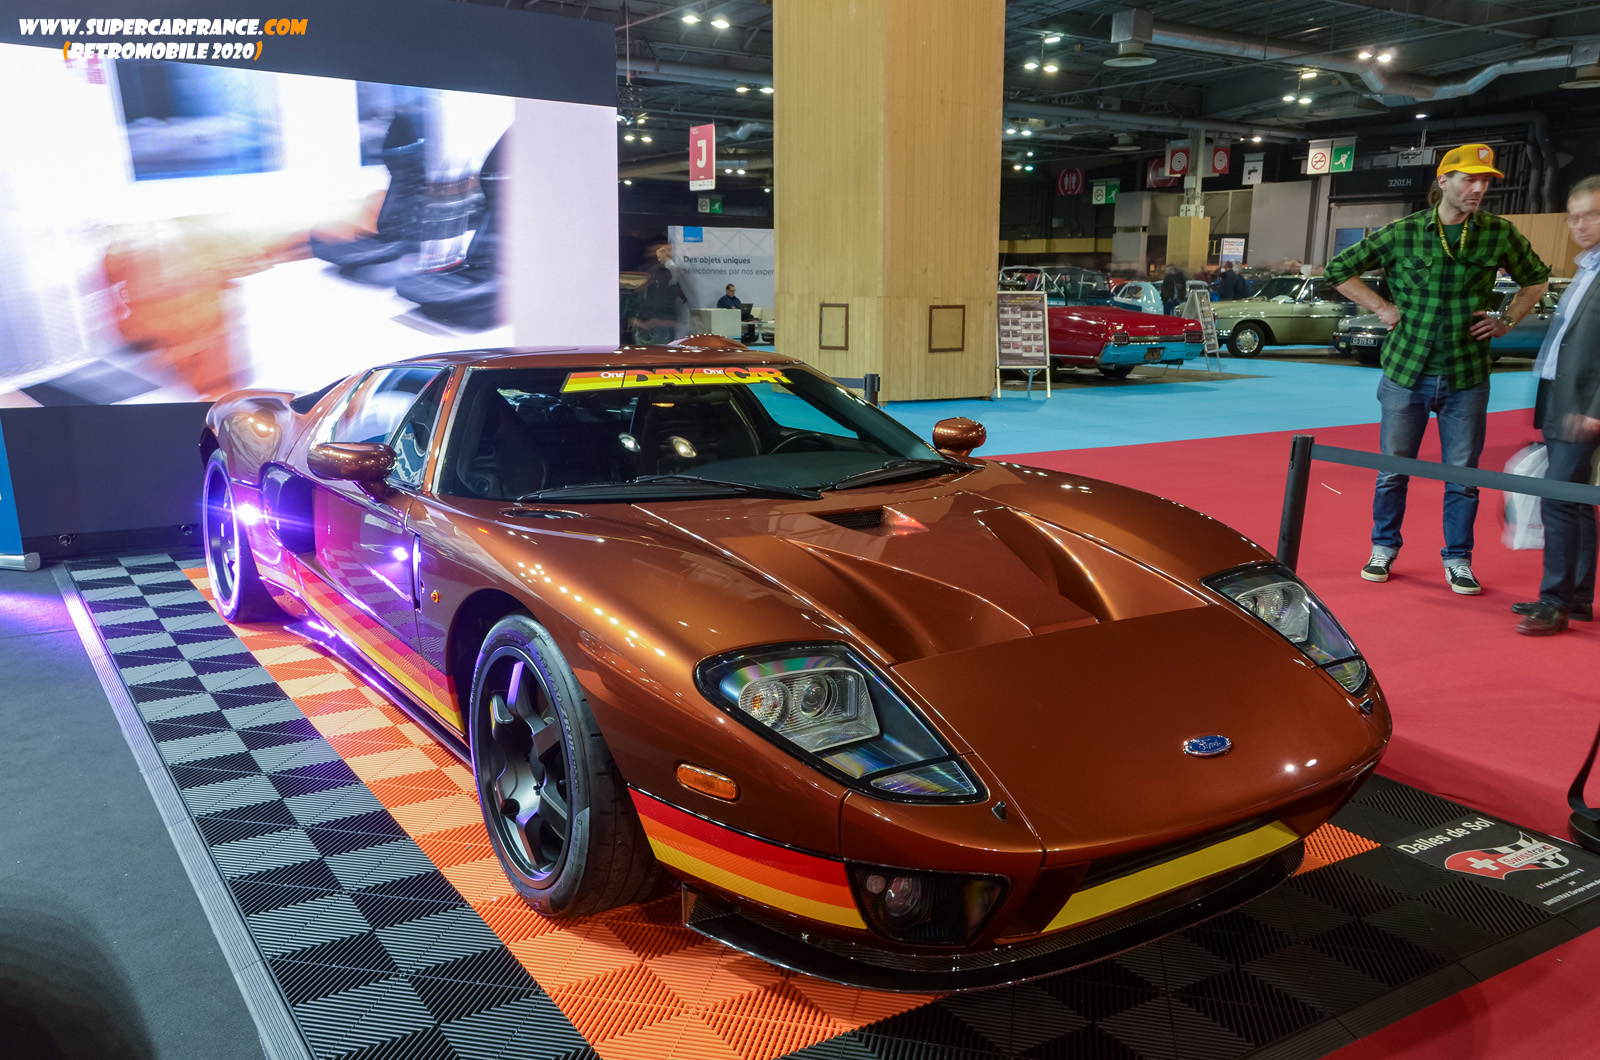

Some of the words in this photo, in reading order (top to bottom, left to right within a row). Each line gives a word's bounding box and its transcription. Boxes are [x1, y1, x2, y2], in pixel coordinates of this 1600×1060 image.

[696, 139, 707, 168] J
[683, 255, 697, 263] Des
[699, 256, 721, 265] objets
[723, 256, 751, 265] uniques
[600, 371, 625, 379] One
[621, 367, 696, 388] DAY
[724, 367, 794, 384] CAR
[1397, 834, 1452, 854] Dalles
[1445, 828, 1471, 838] de
[1461, 817, 1496, 831] Sol
